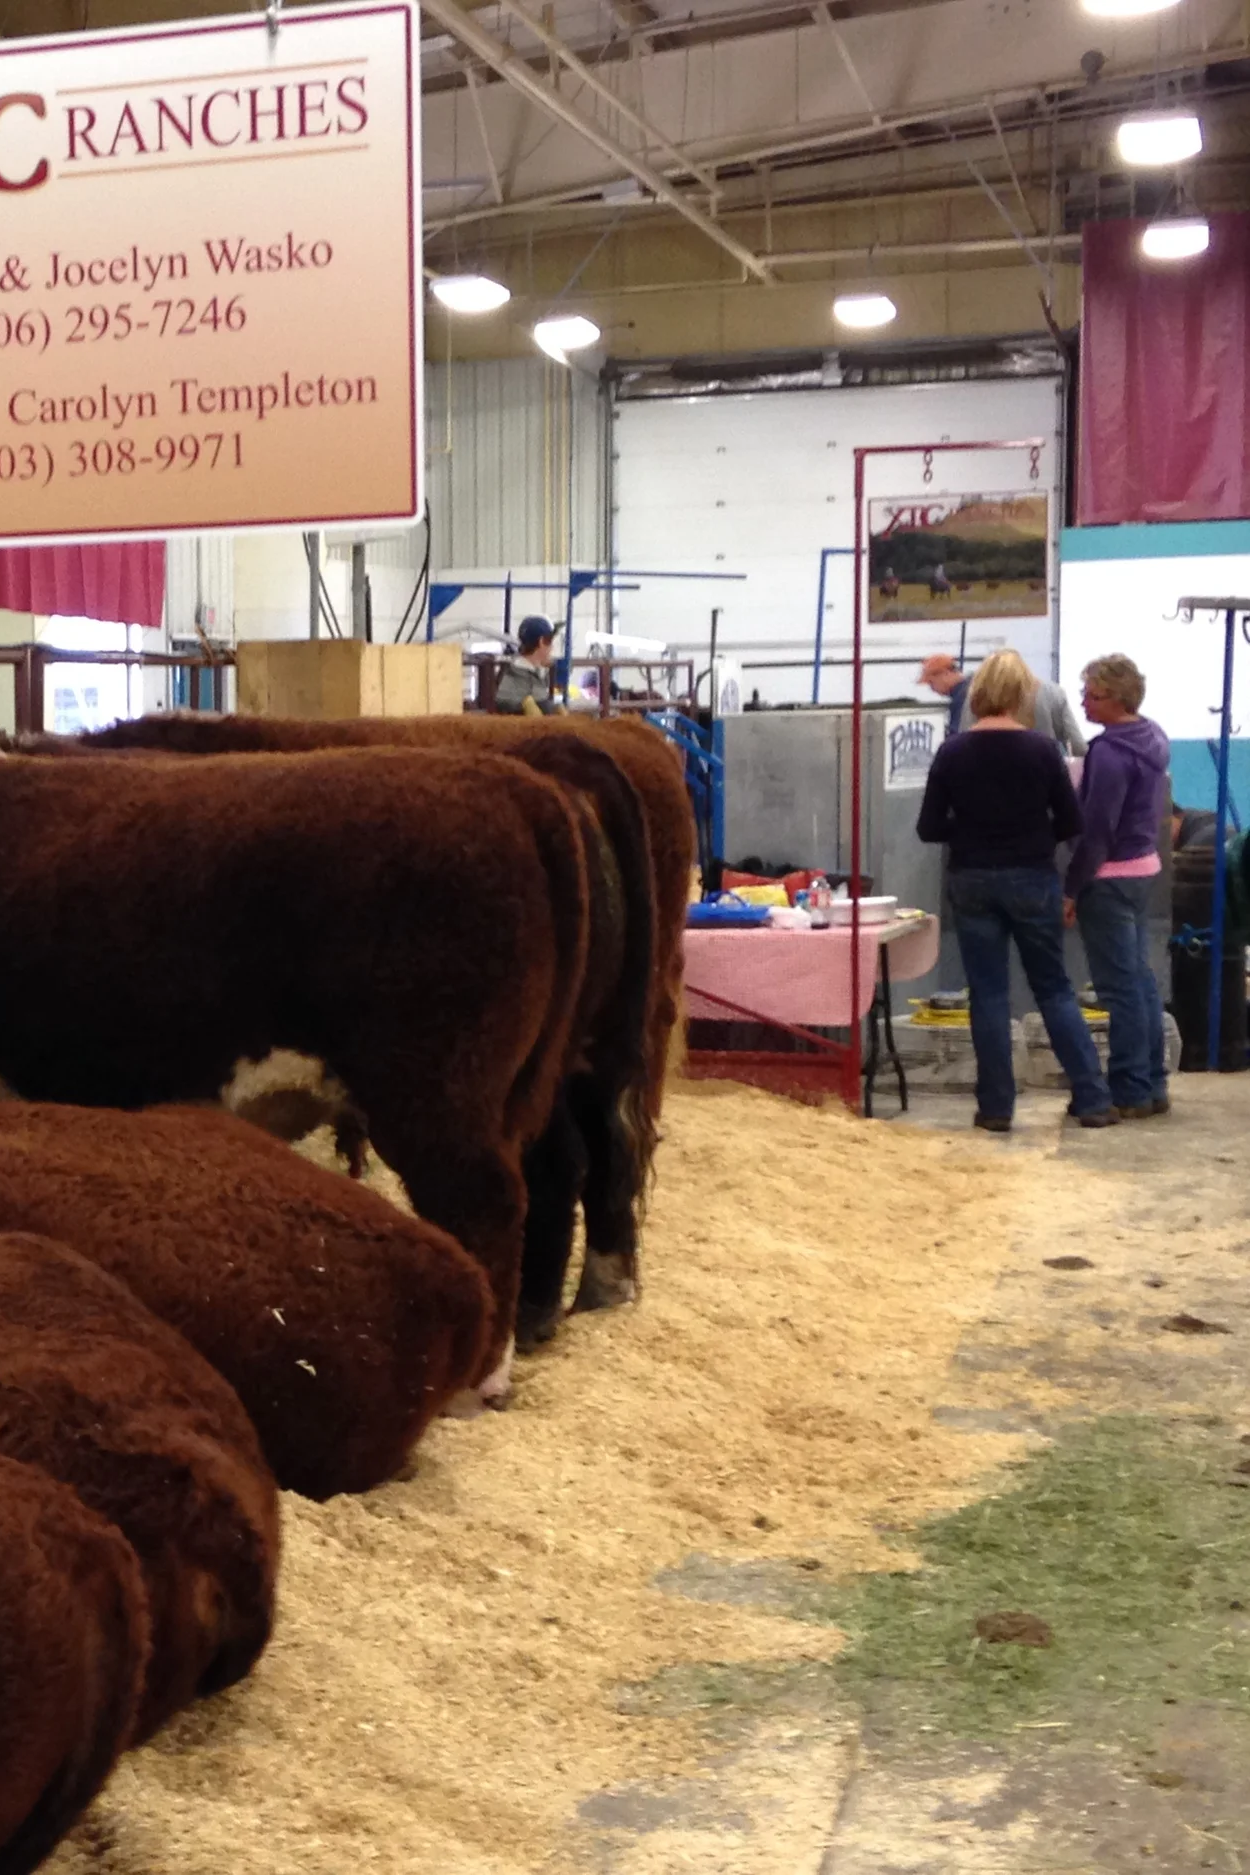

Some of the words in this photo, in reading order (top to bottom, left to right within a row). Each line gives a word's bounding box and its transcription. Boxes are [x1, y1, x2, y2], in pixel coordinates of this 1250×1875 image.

[65, 76, 370, 162] RANCHES
[45, 244, 189, 293] Jocelyn
[203, 231, 335, 275] Wasko
[65, 295, 248, 345] 295-7246
[8, 382, 158, 431] Carolyn
[171, 371, 379, 422] Templeton
[68, 432, 245, 479] 308-9971
